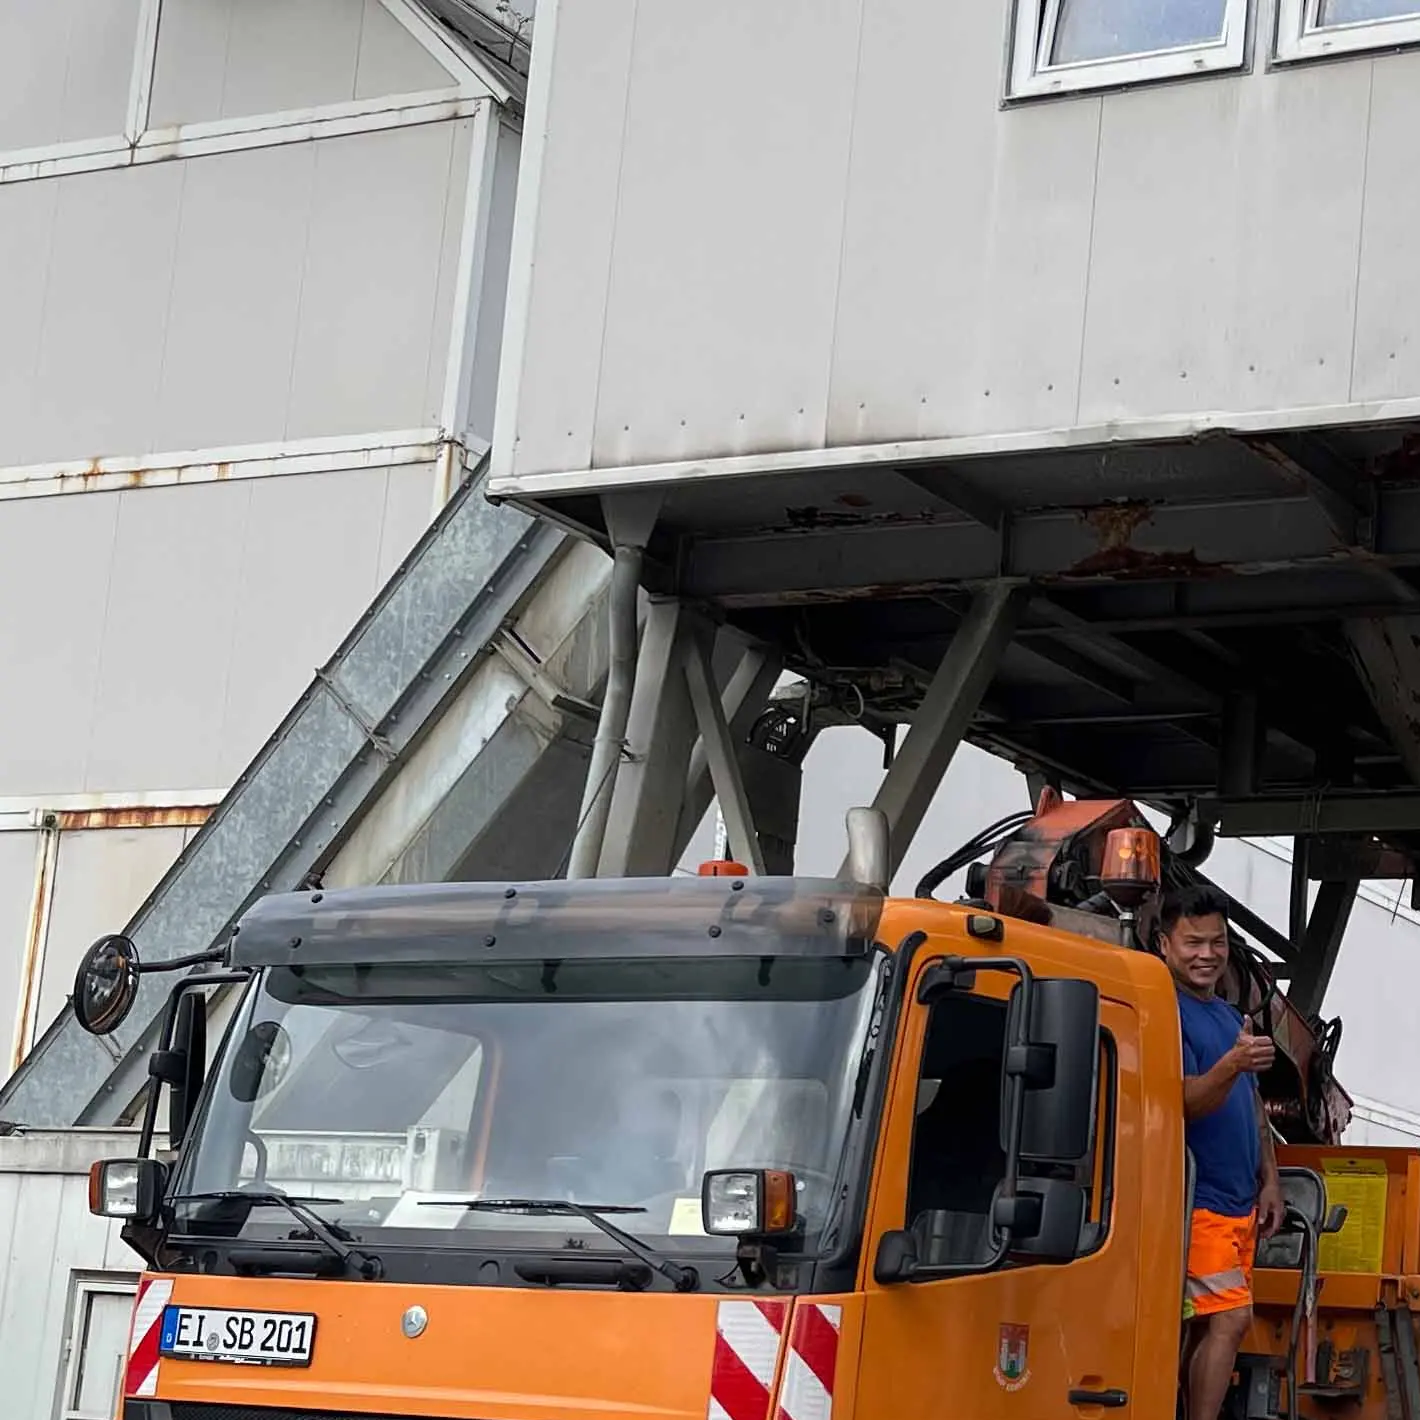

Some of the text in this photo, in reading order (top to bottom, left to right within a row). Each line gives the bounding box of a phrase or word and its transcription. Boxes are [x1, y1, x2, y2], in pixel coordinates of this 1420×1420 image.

[176, 1313, 307, 1354] EI SB 201
